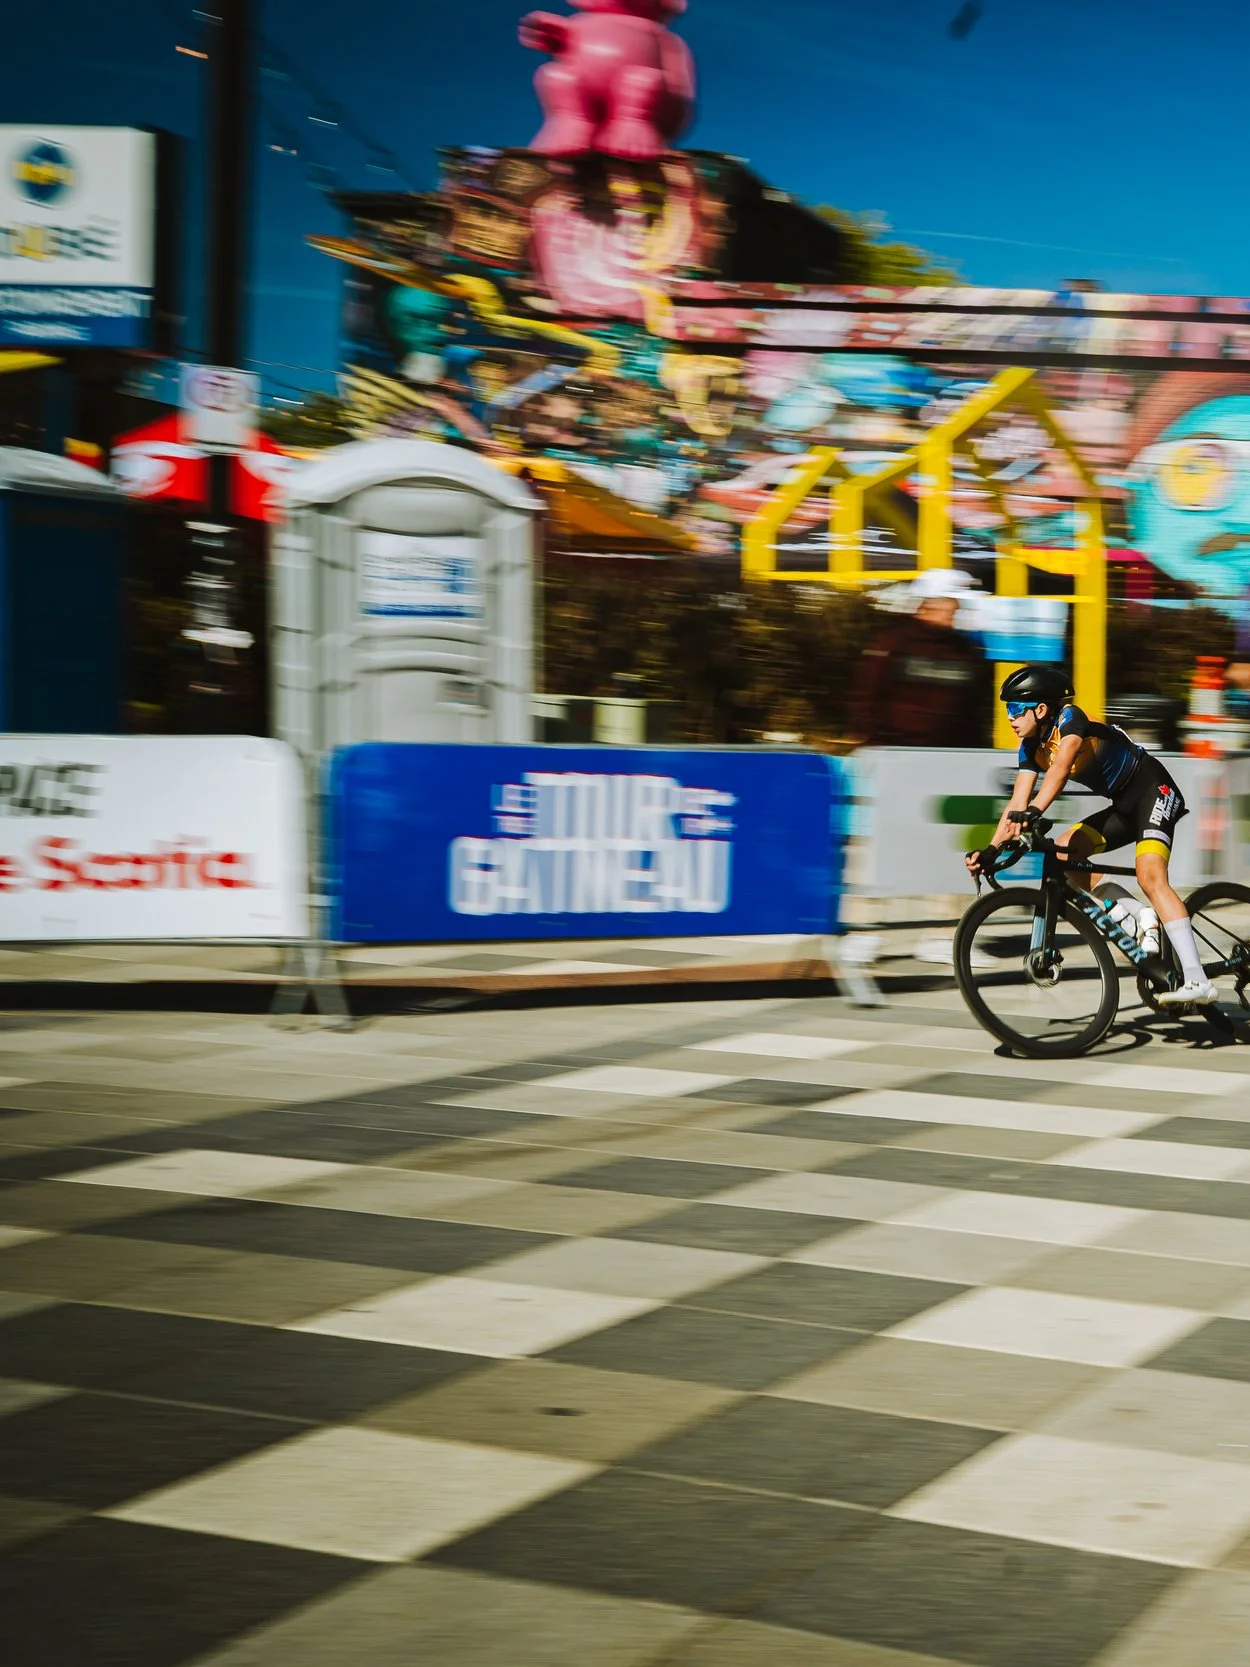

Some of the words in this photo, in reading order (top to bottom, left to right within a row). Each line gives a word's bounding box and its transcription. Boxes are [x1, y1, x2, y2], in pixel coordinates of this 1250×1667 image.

[521, 772, 677, 838] TOUR
[1149, 797, 1165, 826] RIDE
[33, 834, 257, 889] Scotia
[448, 836, 732, 914] GATINEAU
[1073, 893, 1148, 964] ACTOR
